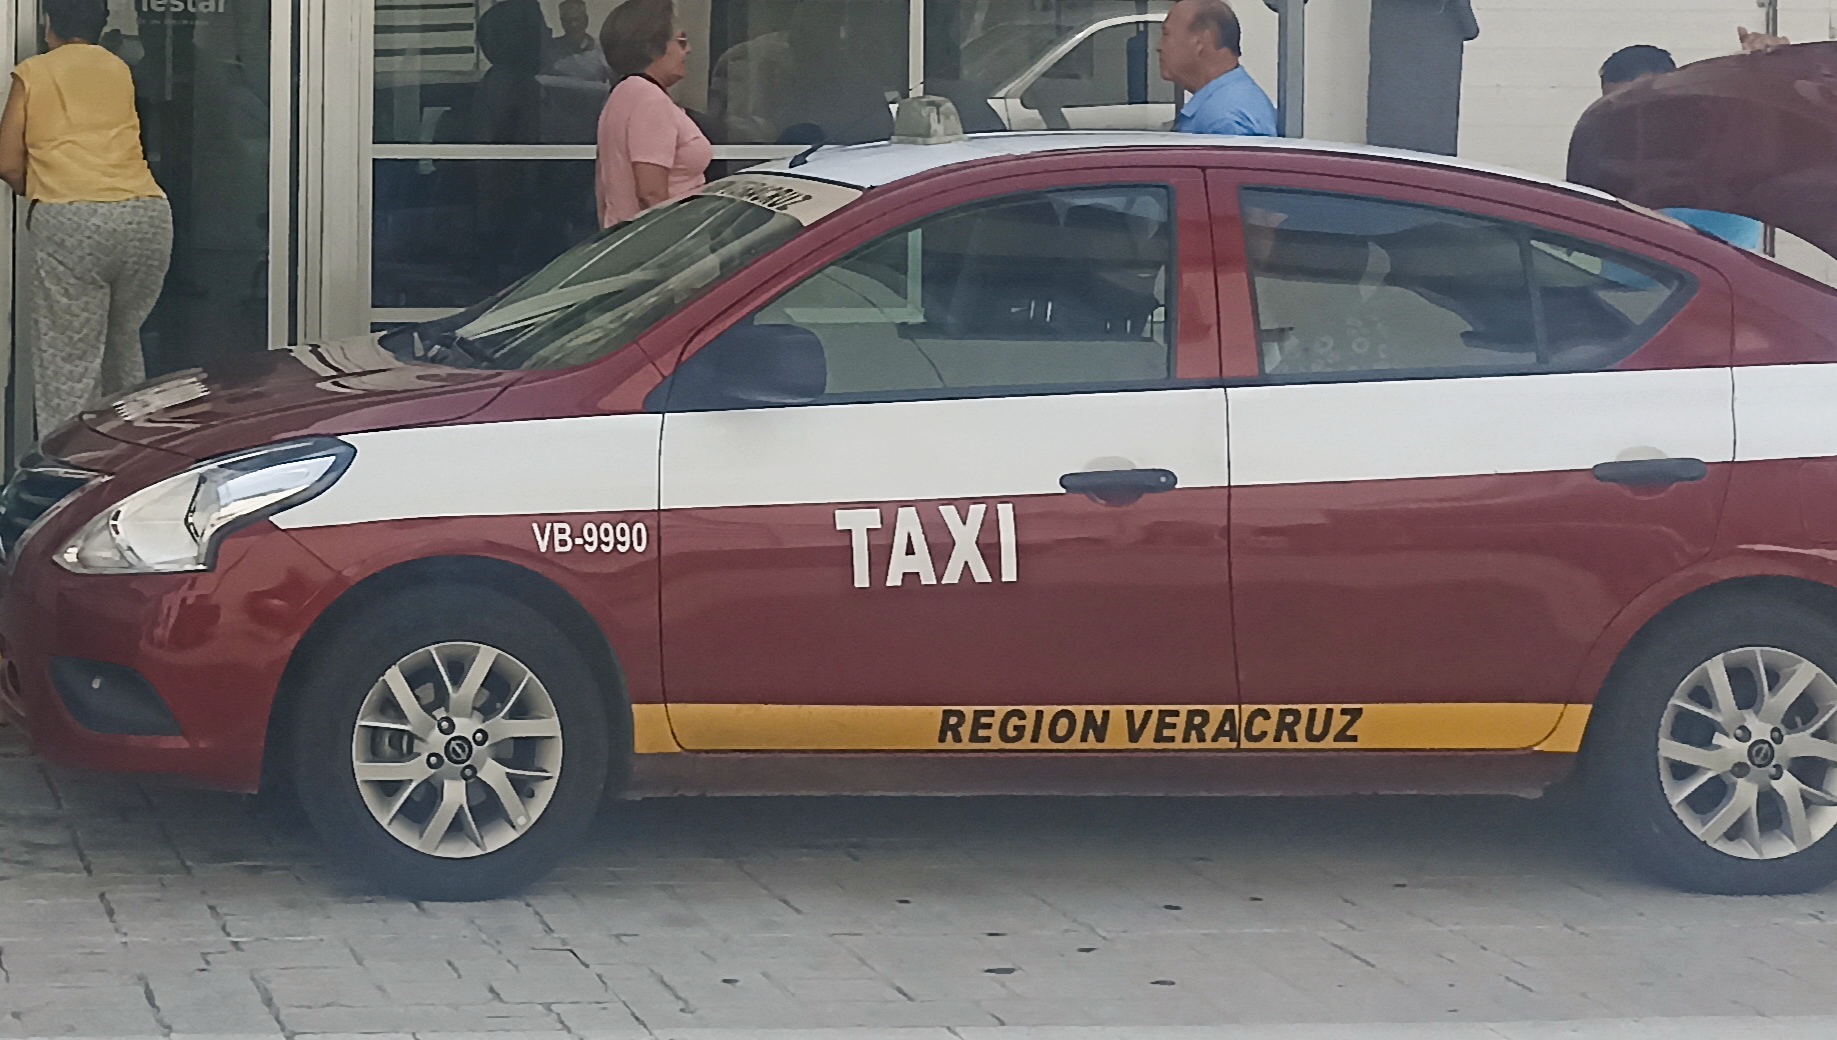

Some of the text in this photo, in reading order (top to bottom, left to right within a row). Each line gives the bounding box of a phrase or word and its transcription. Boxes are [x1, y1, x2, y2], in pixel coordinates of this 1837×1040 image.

[531, 522, 649, 553] VB-9990
[834, 502, 1018, 588] TAXI
[937, 707, 1363, 744] REGION VERACRUZ
